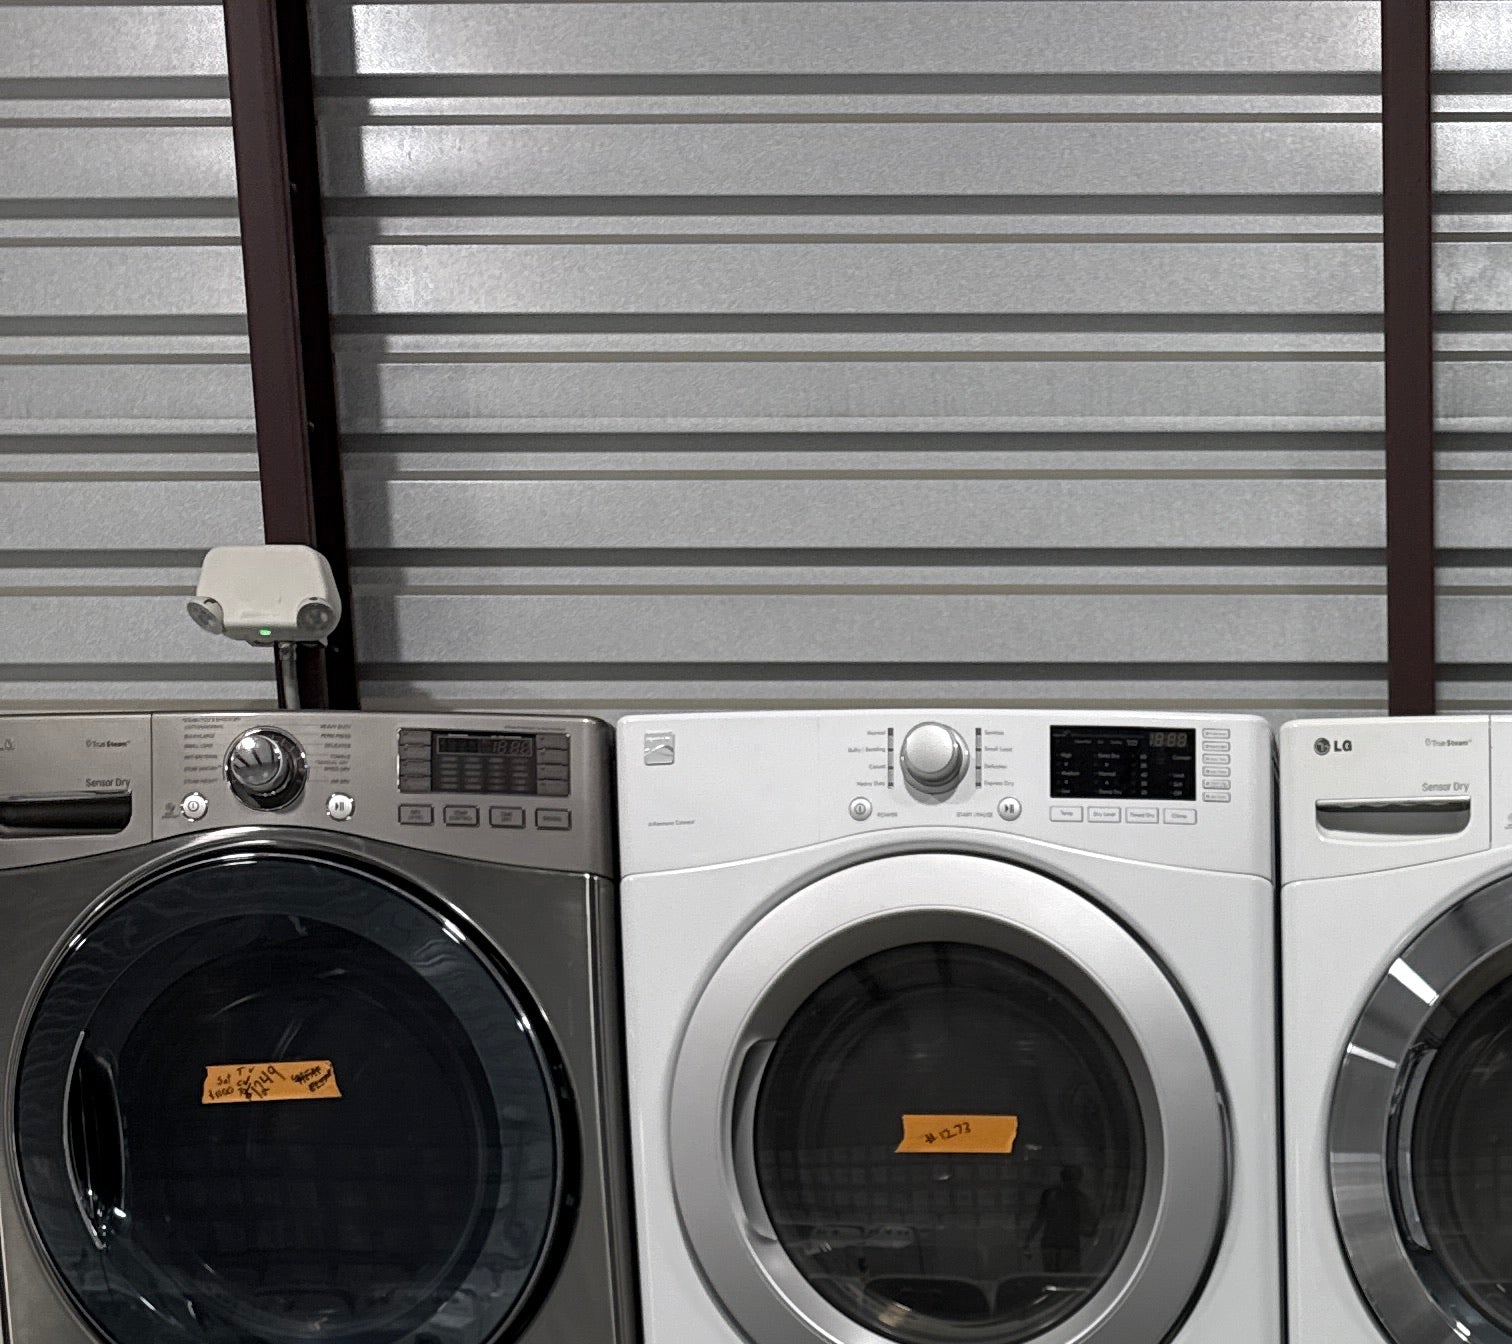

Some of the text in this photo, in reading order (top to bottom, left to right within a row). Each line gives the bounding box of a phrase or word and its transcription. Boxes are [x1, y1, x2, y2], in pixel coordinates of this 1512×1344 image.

[1334, 740, 1352, 752] LG
[86, 778, 130, 788] Sensor Dry
[1422, 782, 1470, 792] Sensor Dry
